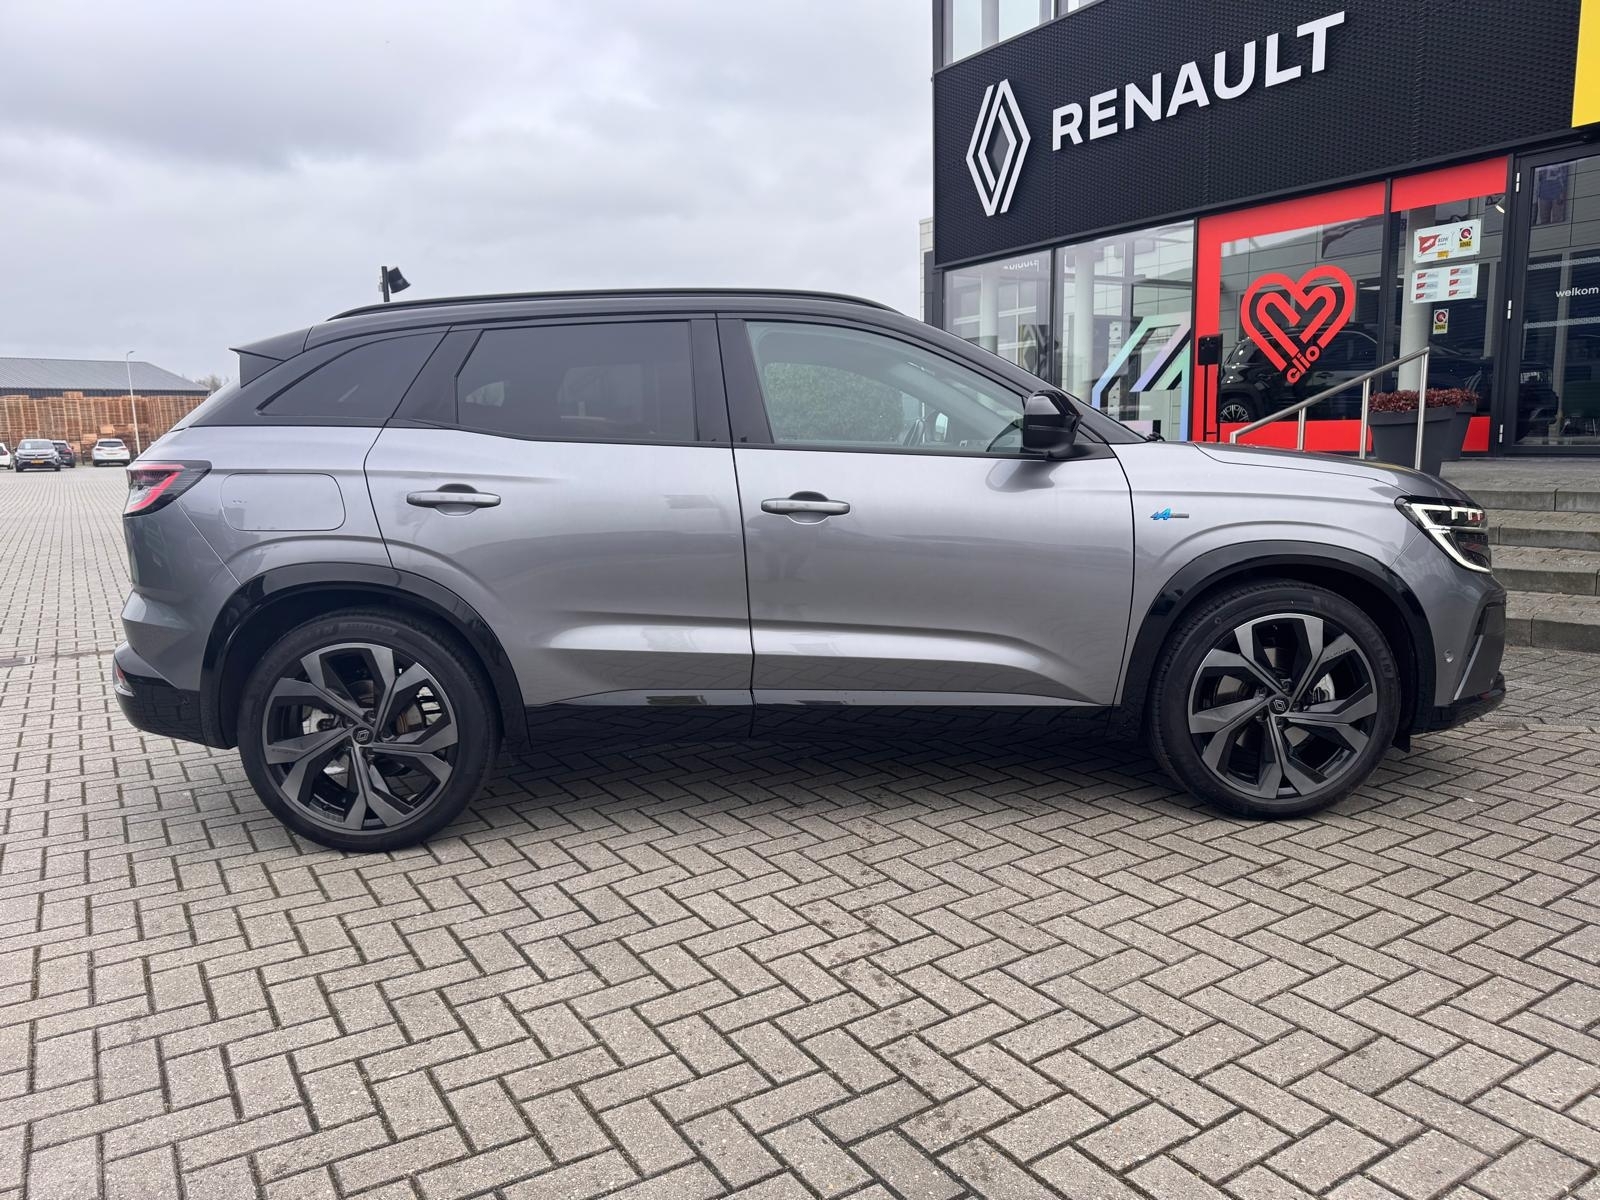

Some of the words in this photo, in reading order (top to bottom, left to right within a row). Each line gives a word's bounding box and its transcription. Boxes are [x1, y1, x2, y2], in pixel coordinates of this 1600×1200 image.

[1052, 11, 1345, 151] RENAULT
[1555, 287, 1599, 297] welkom
[1286, 345, 1320, 384] clio
